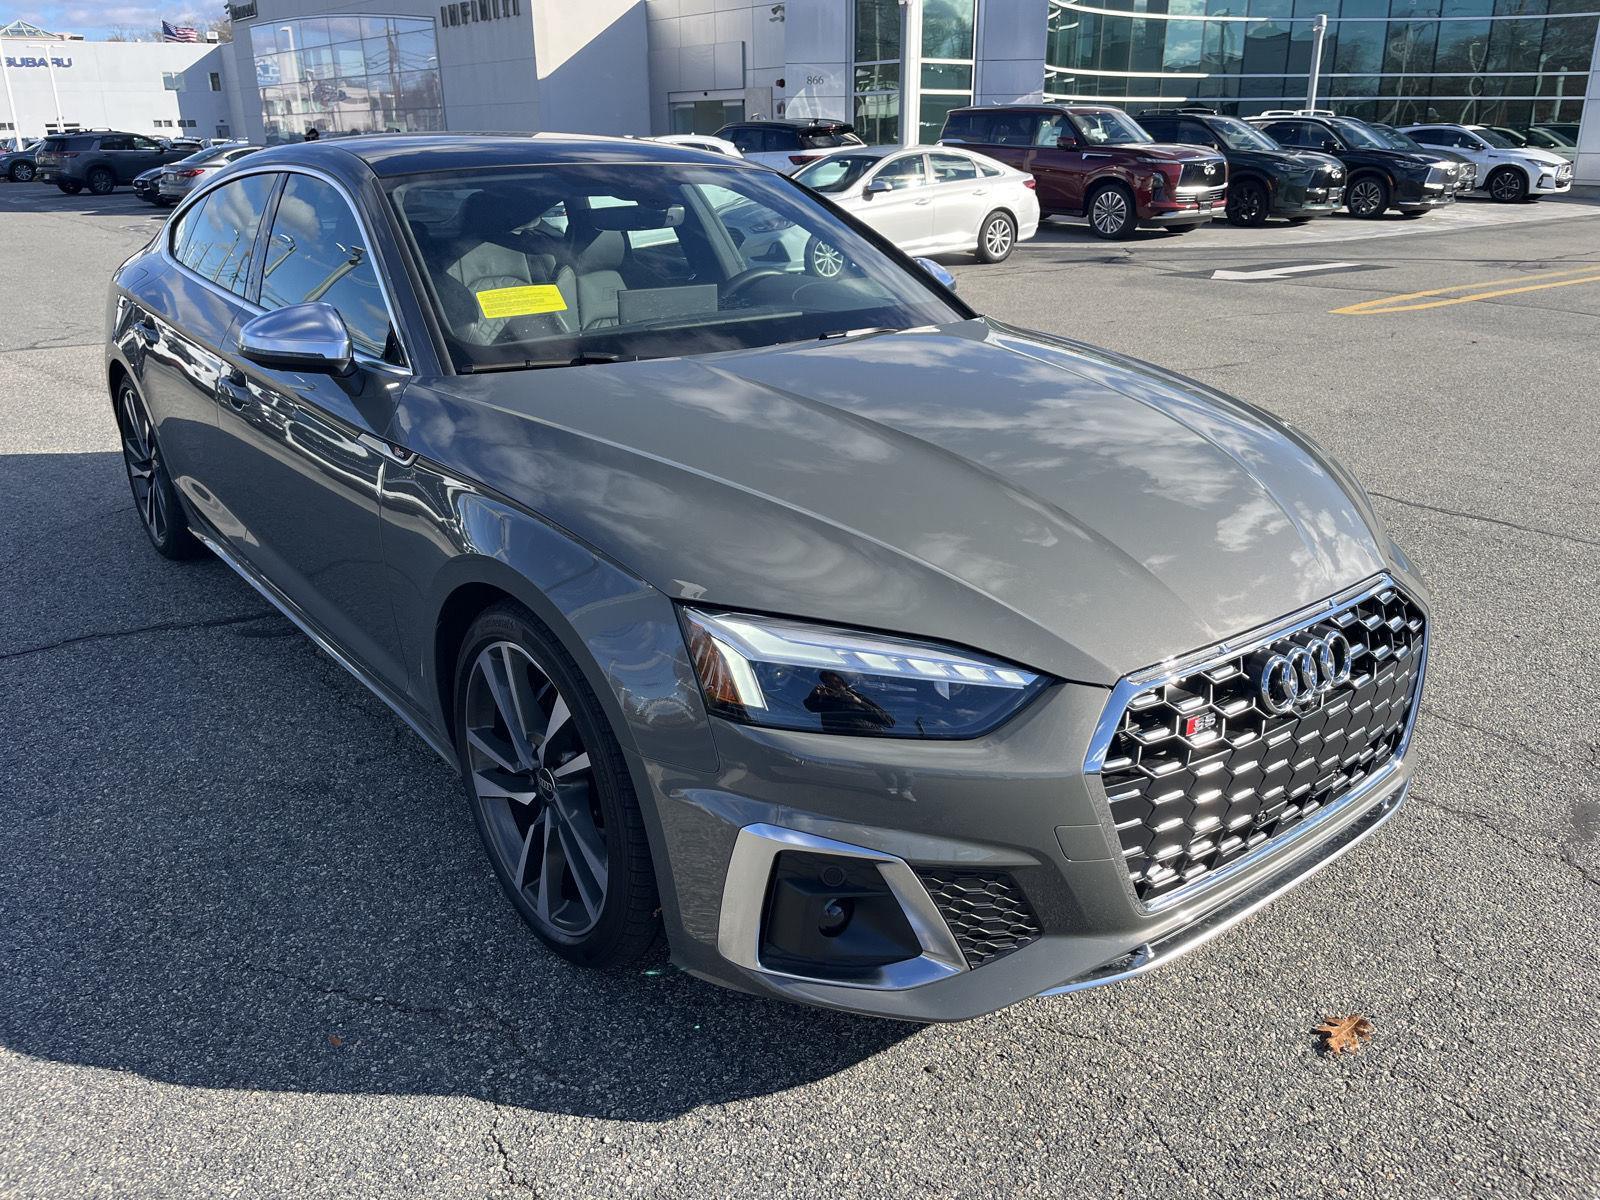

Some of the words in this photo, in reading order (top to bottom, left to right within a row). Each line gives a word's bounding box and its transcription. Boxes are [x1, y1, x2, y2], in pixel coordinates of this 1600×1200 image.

[441, 0, 521, 28] INFINITI
[5, 57, 73, 67] SUBARU
[806, 75, 824, 85] 866
